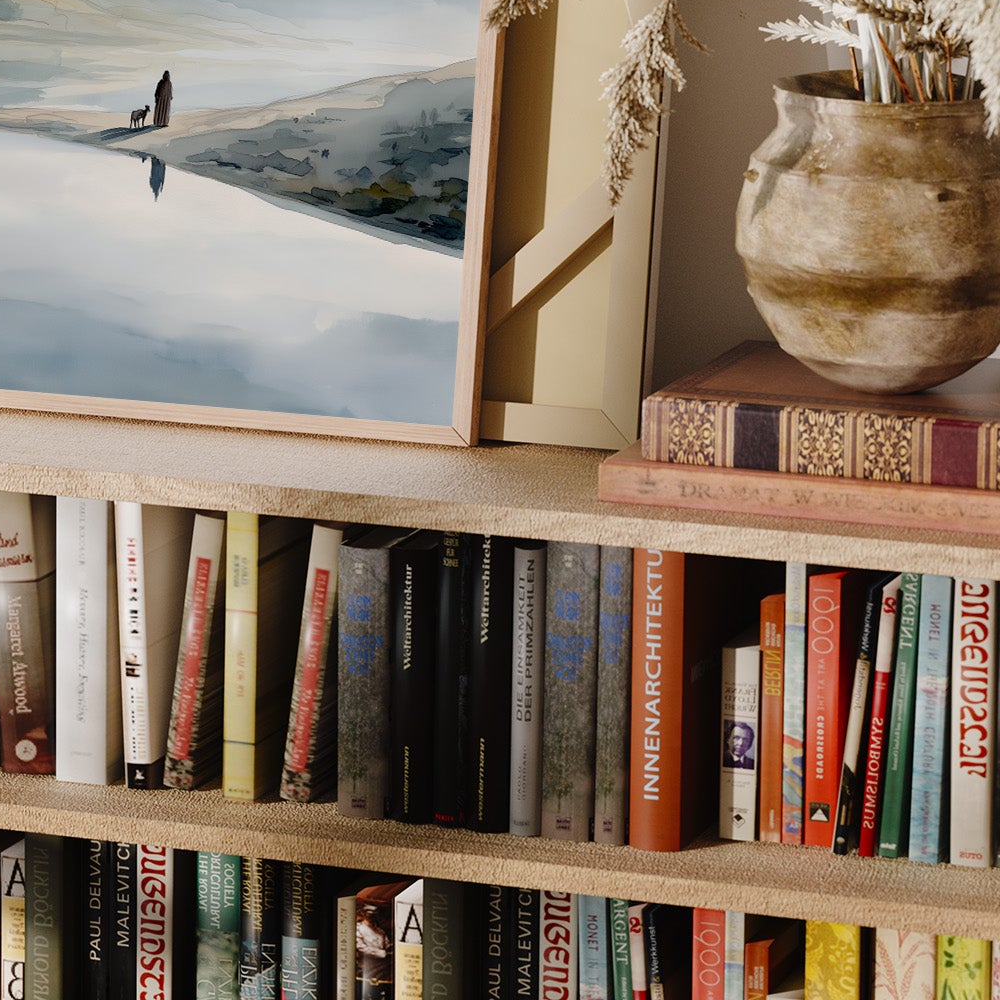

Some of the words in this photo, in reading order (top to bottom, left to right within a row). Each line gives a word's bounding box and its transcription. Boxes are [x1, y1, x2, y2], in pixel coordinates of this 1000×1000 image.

[6, 595, 24, 658] Margaret
[403, 563, 412, 671] Weltarchitektur
[517, 573, 526, 686] EINSAMKEIT
[525, 558, 535, 679] PRIMZAHLEN
[11, 661, 31, 714] Atwood
[515, 690, 524, 721] DIE
[524, 684, 533, 723] DER
[643, 548, 664, 801] INNENARCHITEKTU
[403, 744, 411, 814] westermann
[478, 737, 486, 822] westermann
[90, 839, 102, 910] DELVAU
[89, 915, 102, 962] PAUL
[487, 885, 502, 957] DELVAU
[587, 914, 597, 951] MONET
[613, 898, 629, 965] ARGENT
[629, 917, 641, 935] 2
[649, 926, 659, 975] Werkkunst
[695, 921, 721, 987] 1900
[587, 958, 597, 974] IN
